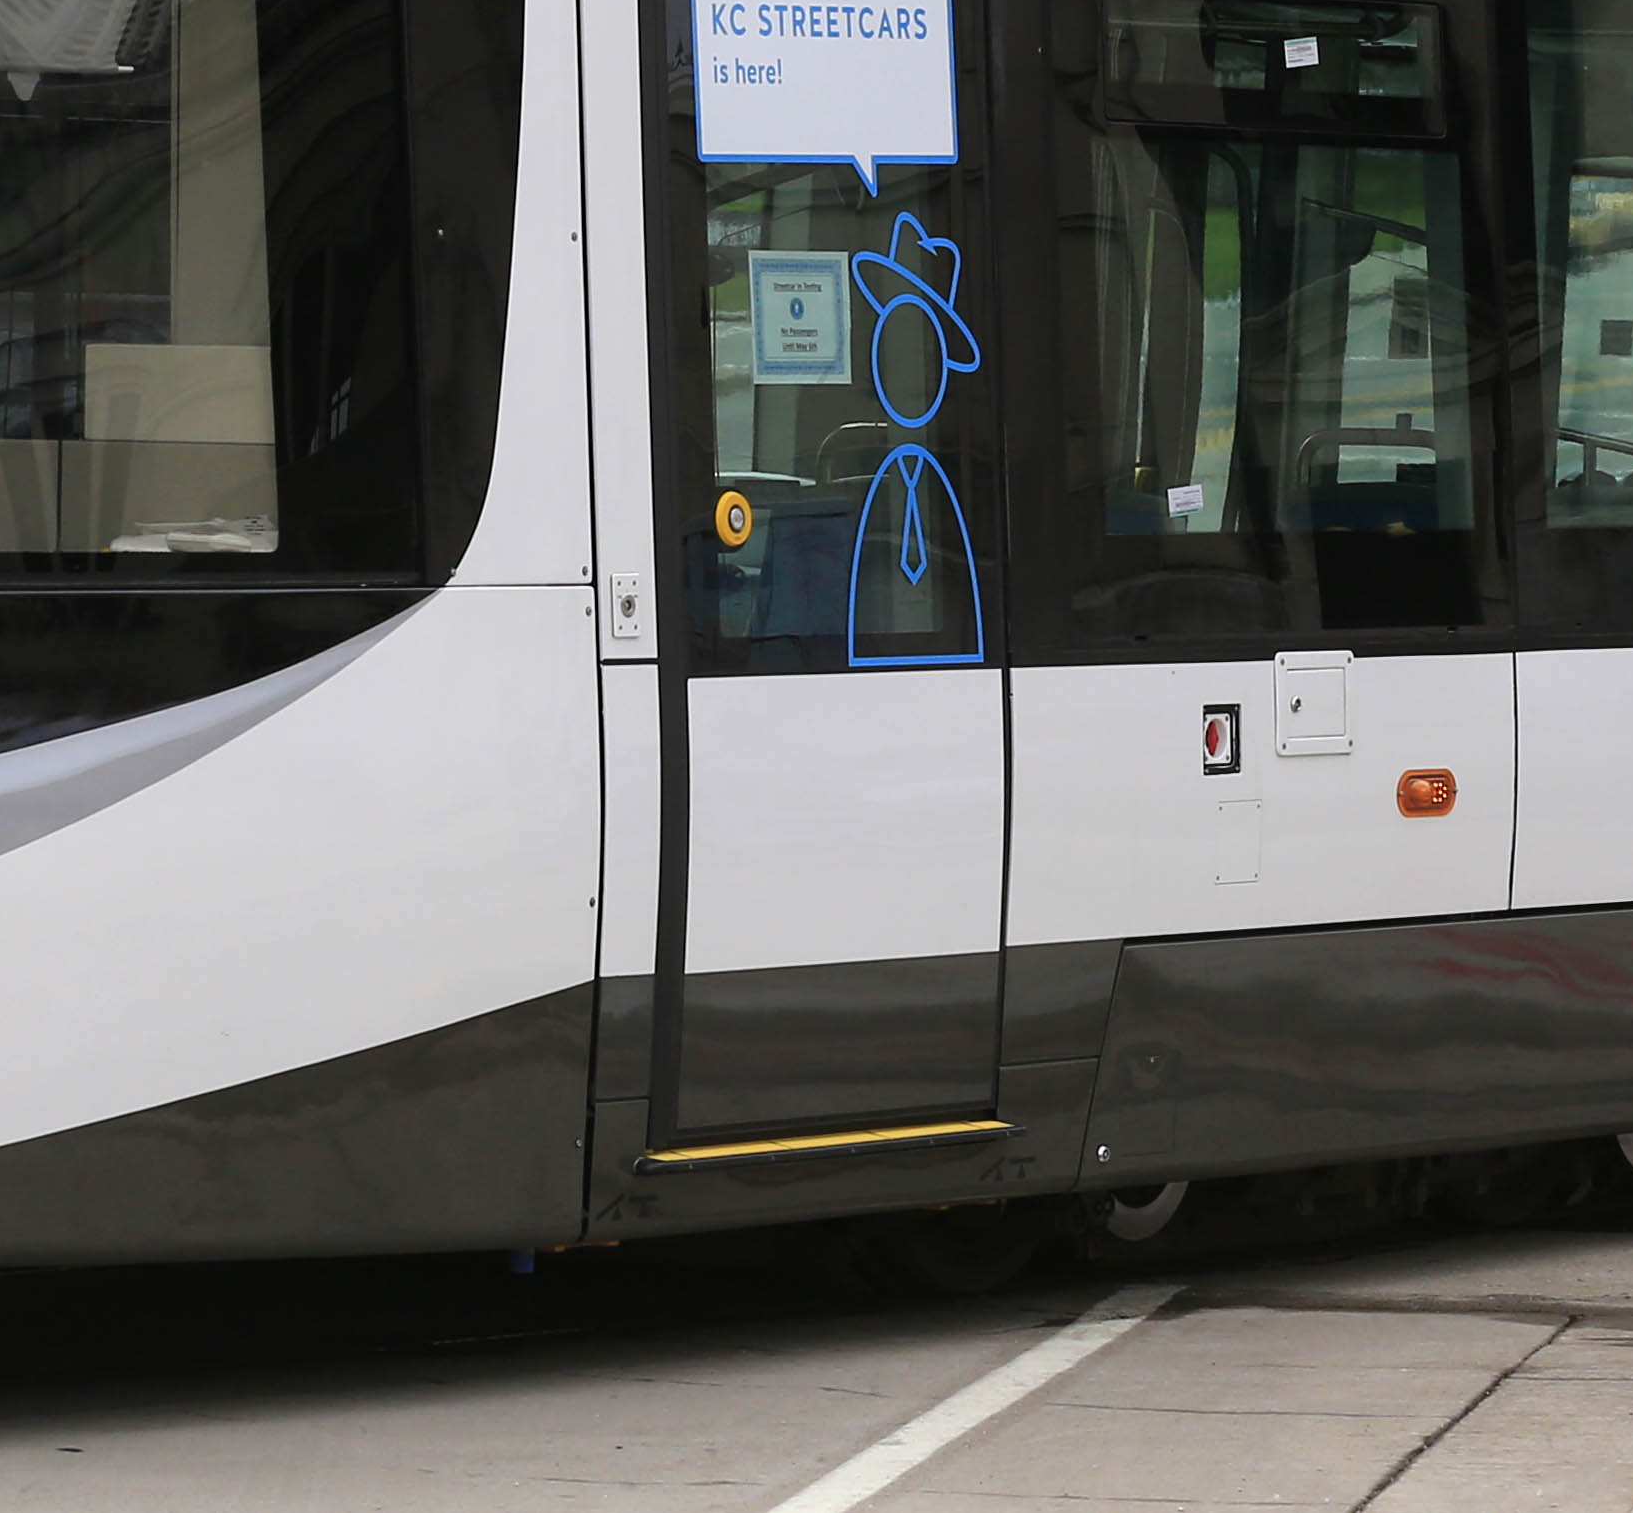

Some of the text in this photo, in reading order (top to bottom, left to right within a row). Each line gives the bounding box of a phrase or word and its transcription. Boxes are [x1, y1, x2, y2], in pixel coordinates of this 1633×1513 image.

[711, 3, 929, 40] KC STREETCARS
[713, 56, 783, 85] is here!
